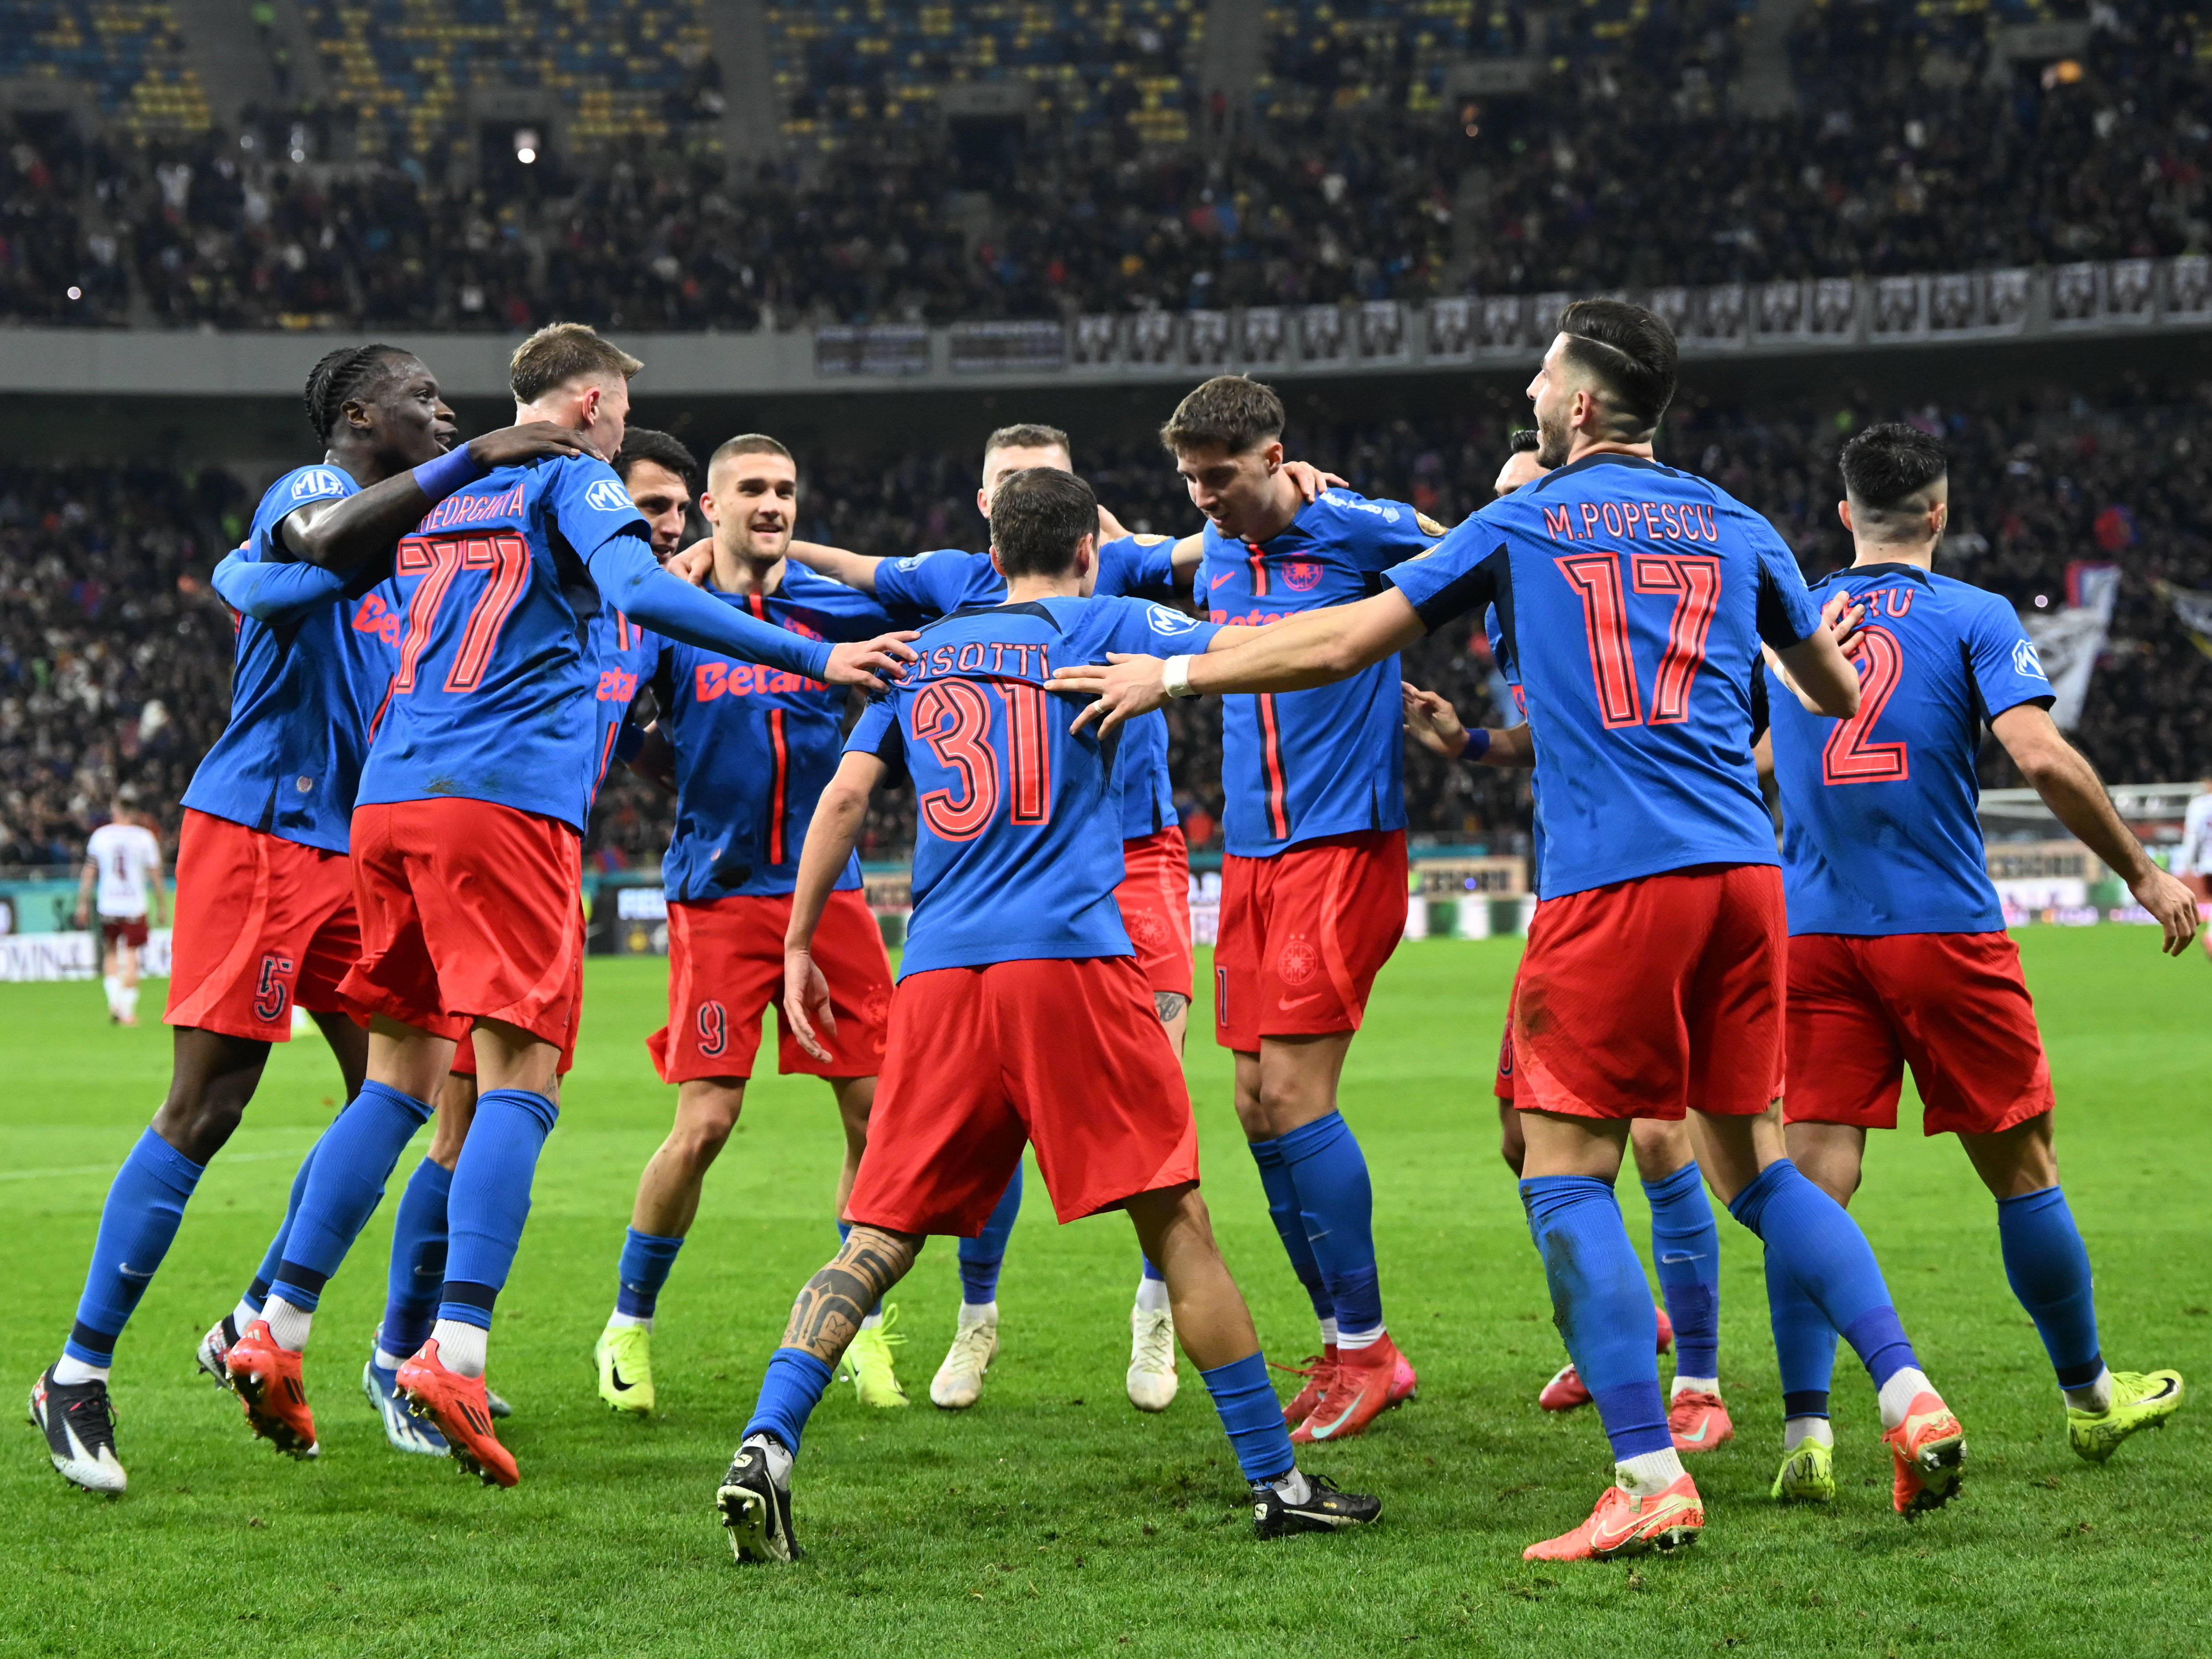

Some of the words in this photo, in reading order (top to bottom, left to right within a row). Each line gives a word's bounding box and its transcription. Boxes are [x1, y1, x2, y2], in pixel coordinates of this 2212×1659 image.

[1542, 502, 1719, 543] M.POPESCU
[392, 531, 531, 694] 77
[1554, 551, 1720, 730] 17
[911, 674, 1050, 842] 31
[1821, 625, 1909, 786] 2
[254, 954, 295, 1023] 5
[696, 999, 729, 1059] 9
